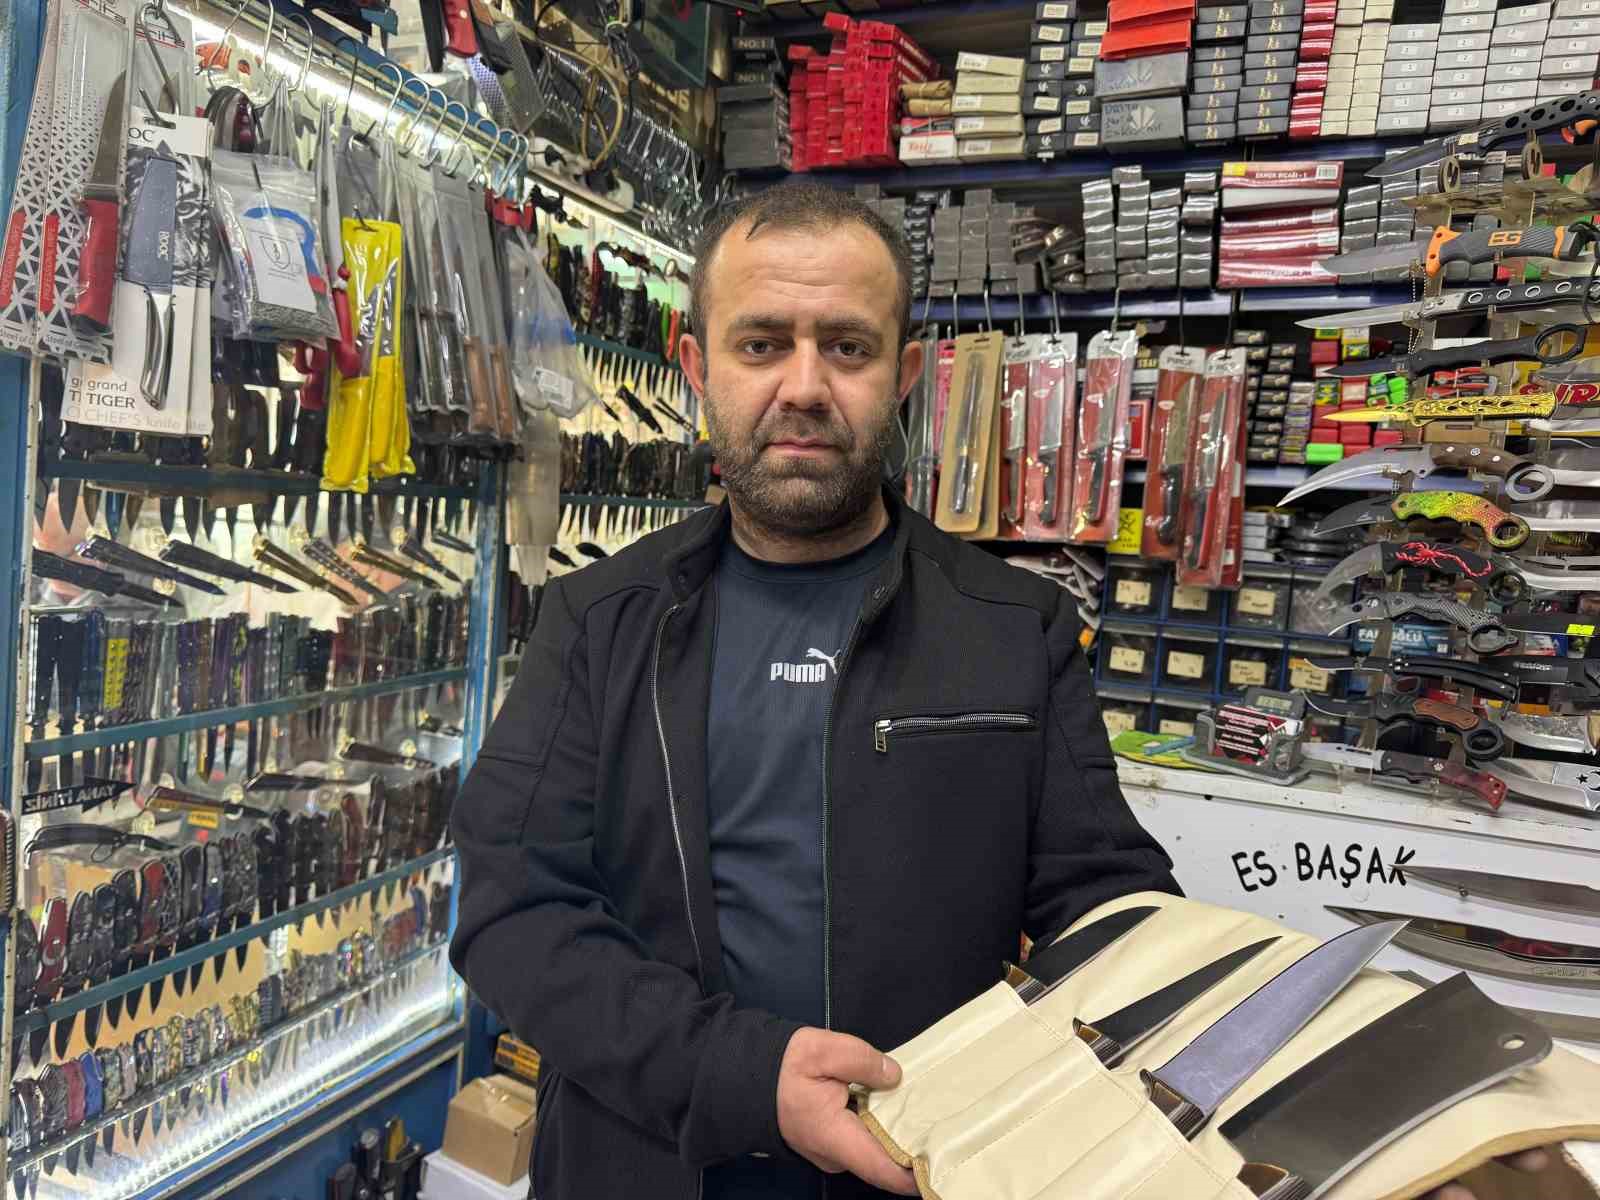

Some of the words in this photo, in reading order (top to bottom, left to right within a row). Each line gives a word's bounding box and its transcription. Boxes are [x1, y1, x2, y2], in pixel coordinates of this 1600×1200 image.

[87, 380, 128, 392] grand
[86, 392, 136, 409] TIGER
[771, 662, 827, 683] PUMA
[1294, 842, 1416, 889] BAŞAK
